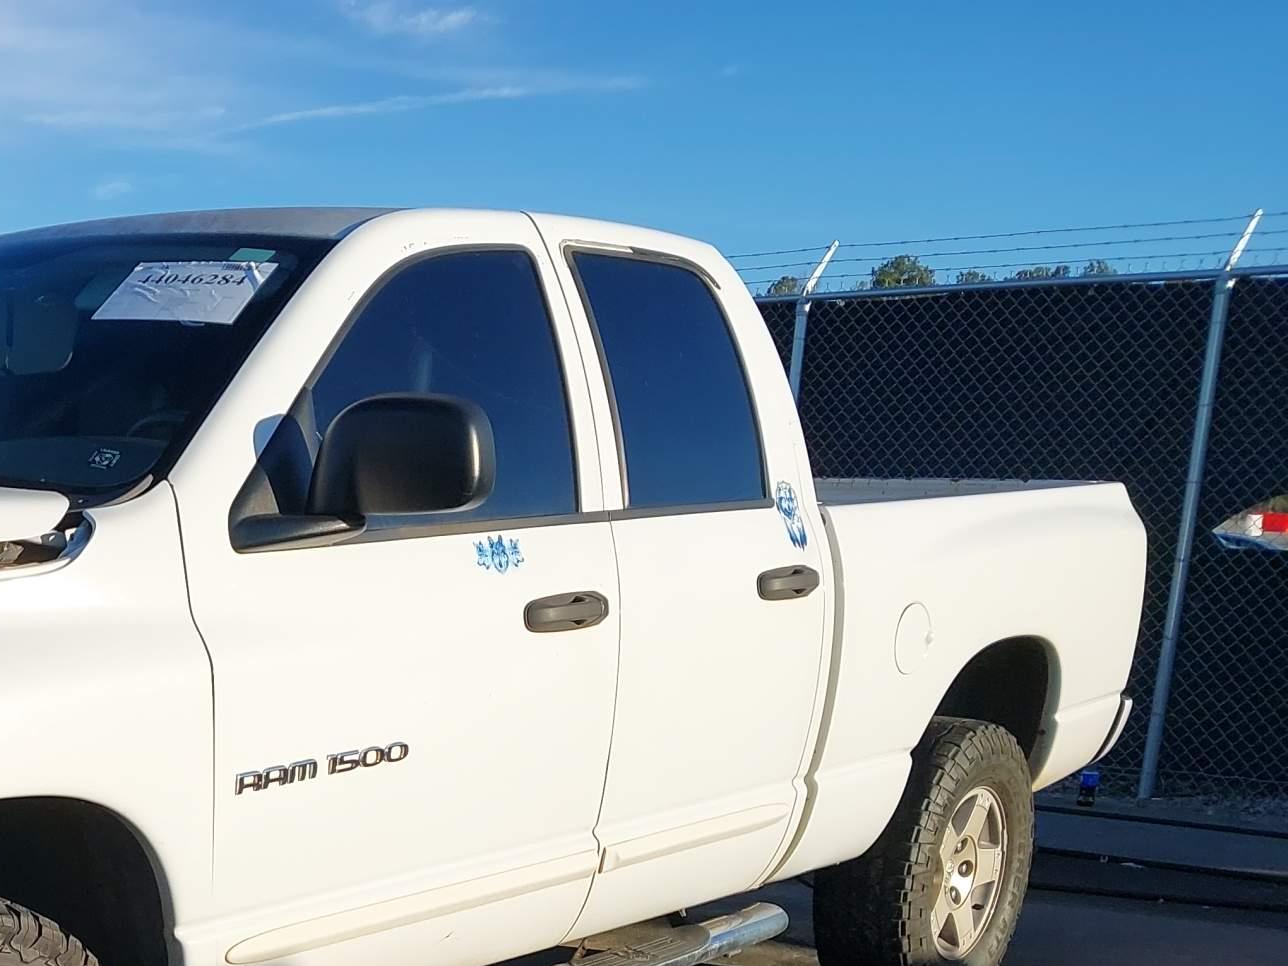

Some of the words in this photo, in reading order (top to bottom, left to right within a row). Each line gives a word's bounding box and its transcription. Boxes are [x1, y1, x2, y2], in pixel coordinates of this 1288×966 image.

[138, 272, 247, 286] 44046284
[234, 758, 318, 796] RAM
[326, 741, 410, 776] 1500
